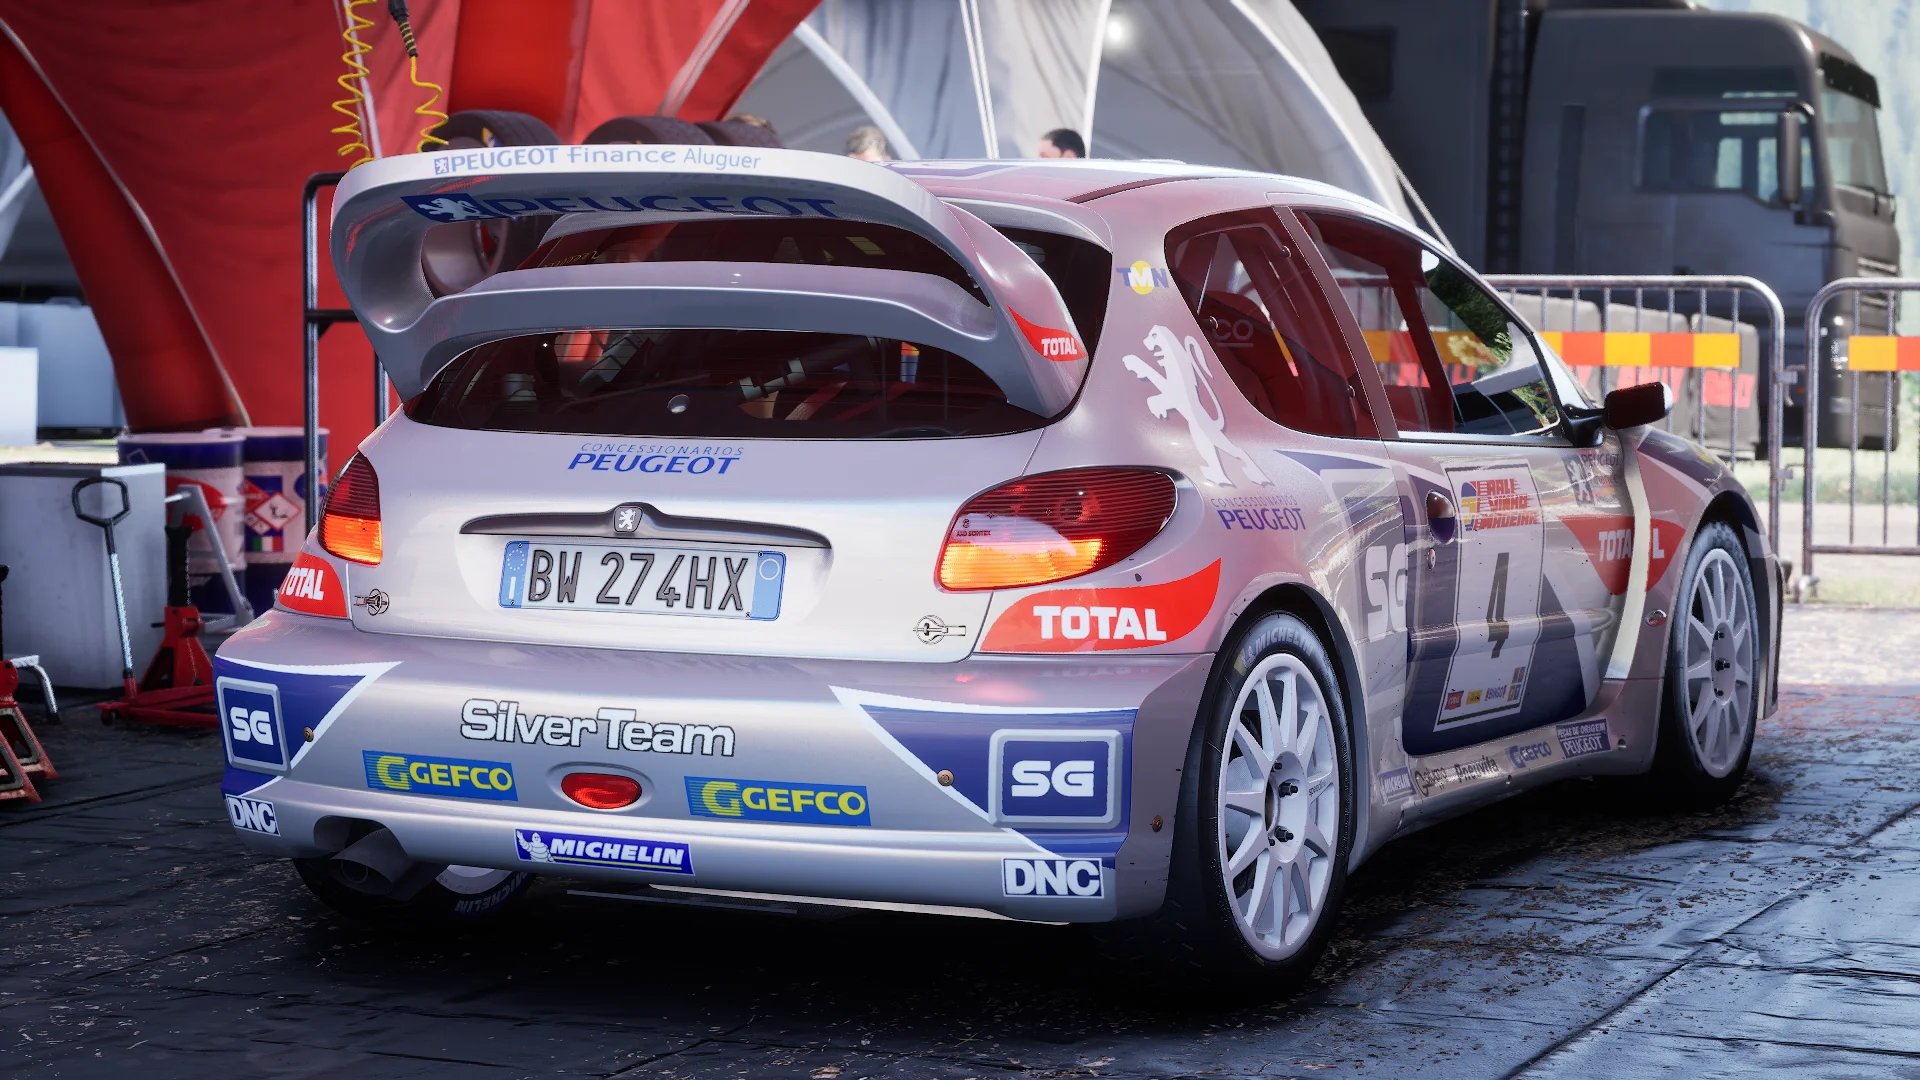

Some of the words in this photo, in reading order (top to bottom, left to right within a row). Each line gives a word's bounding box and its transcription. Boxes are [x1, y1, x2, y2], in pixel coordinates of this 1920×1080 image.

[451, 147, 559, 172] PEUGEOT
[567, 146, 676, 164] Finance
[683, 147, 761, 171] Aluguer
[1116, 266, 1169, 289] TMN
[1041, 336, 1078, 356] TOTAL
[567, 452, 740, 475] PEUGEOT
[581, 442, 745, 456] CONCESSIONARIOS
[1217, 507, 1306, 531] PEUGEOT
[281, 566, 325, 601] TOTAL
[528, 549, 583, 604] BW
[596, 551, 749, 611] 274HX
[1486, 552, 1509, 659] 4
[1033, 605, 1168, 641] TOTAL
[229, 706, 274, 745] SG
[1563, 735, 1603, 756] PEUGEOT
[409, 761, 513, 791] GEFCO
[1011, 760, 1095, 798] SG
[227, 796, 278, 835] DNC
[741, 784, 867, 817] GEFCO
[549, 837, 686, 867] MICHELIN
[1003, 859, 1101, 897] DNC
